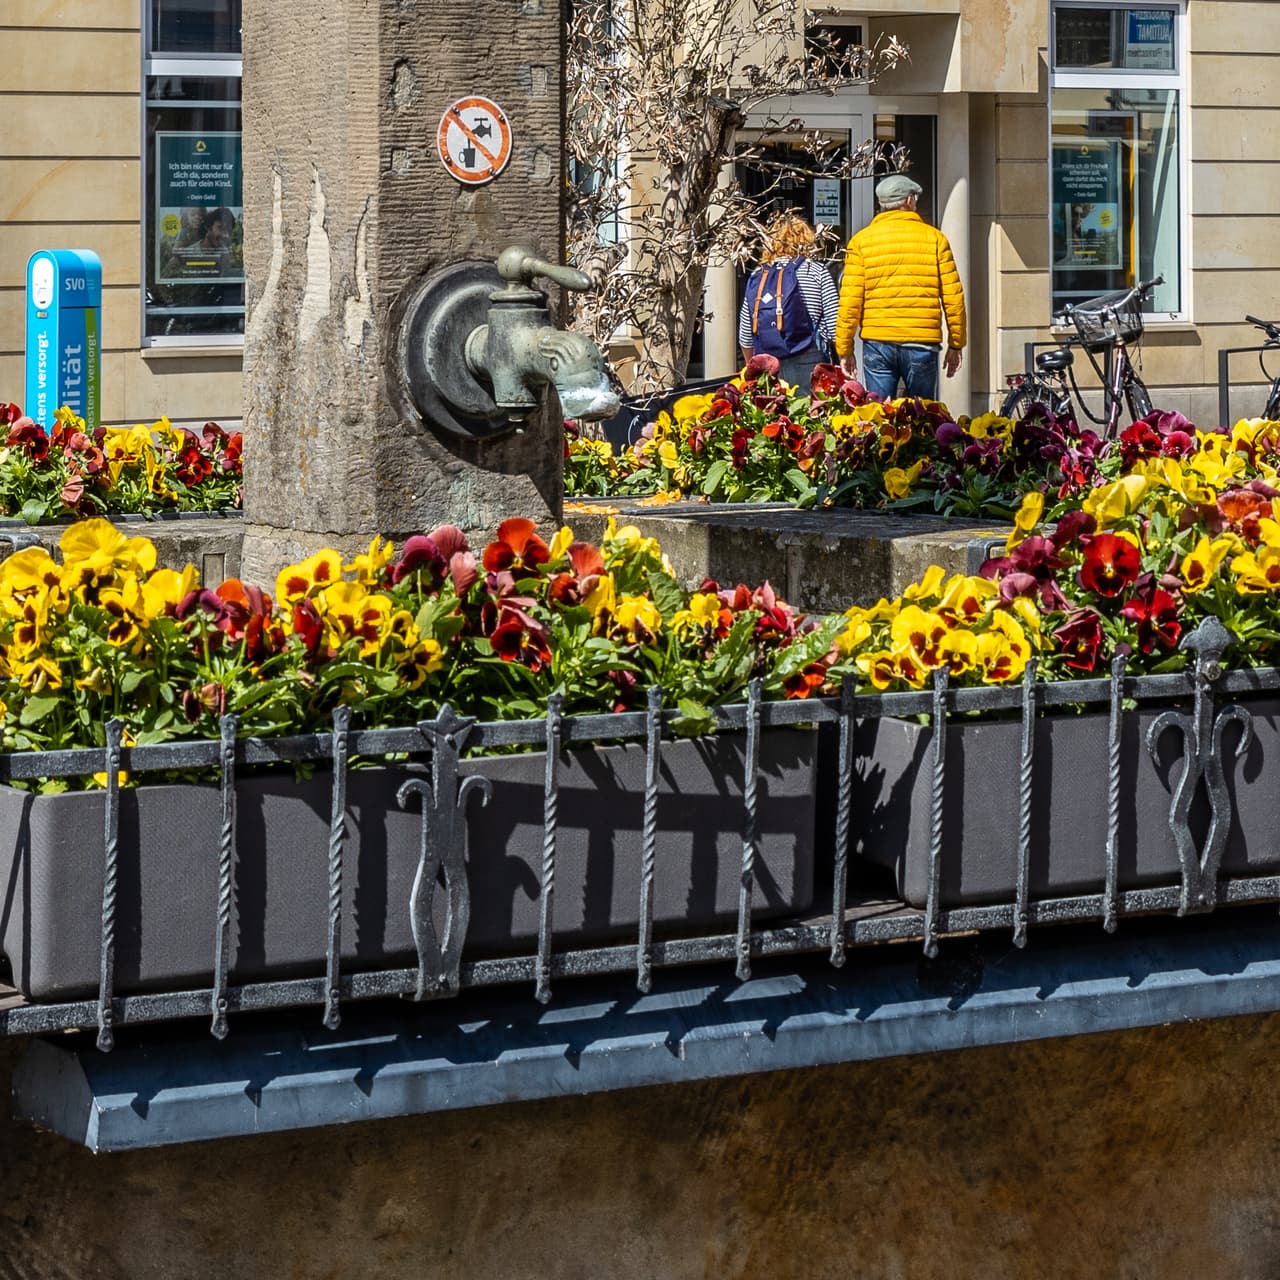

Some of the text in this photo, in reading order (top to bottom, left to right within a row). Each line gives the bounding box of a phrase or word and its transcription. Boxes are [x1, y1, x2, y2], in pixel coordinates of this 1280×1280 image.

[168, 162, 179, 170] Ich
[181, 162, 192, 170] bin
[193, 162, 209, 170] nicht
[223, 162, 233, 170] für
[173, 171, 188, 179] dich
[201, 171, 229, 179] sondern
[65, 278, 85, 291] SVO
[36, 330, 49, 389] versorgt.
[87, 332, 97, 383] versorgt.
